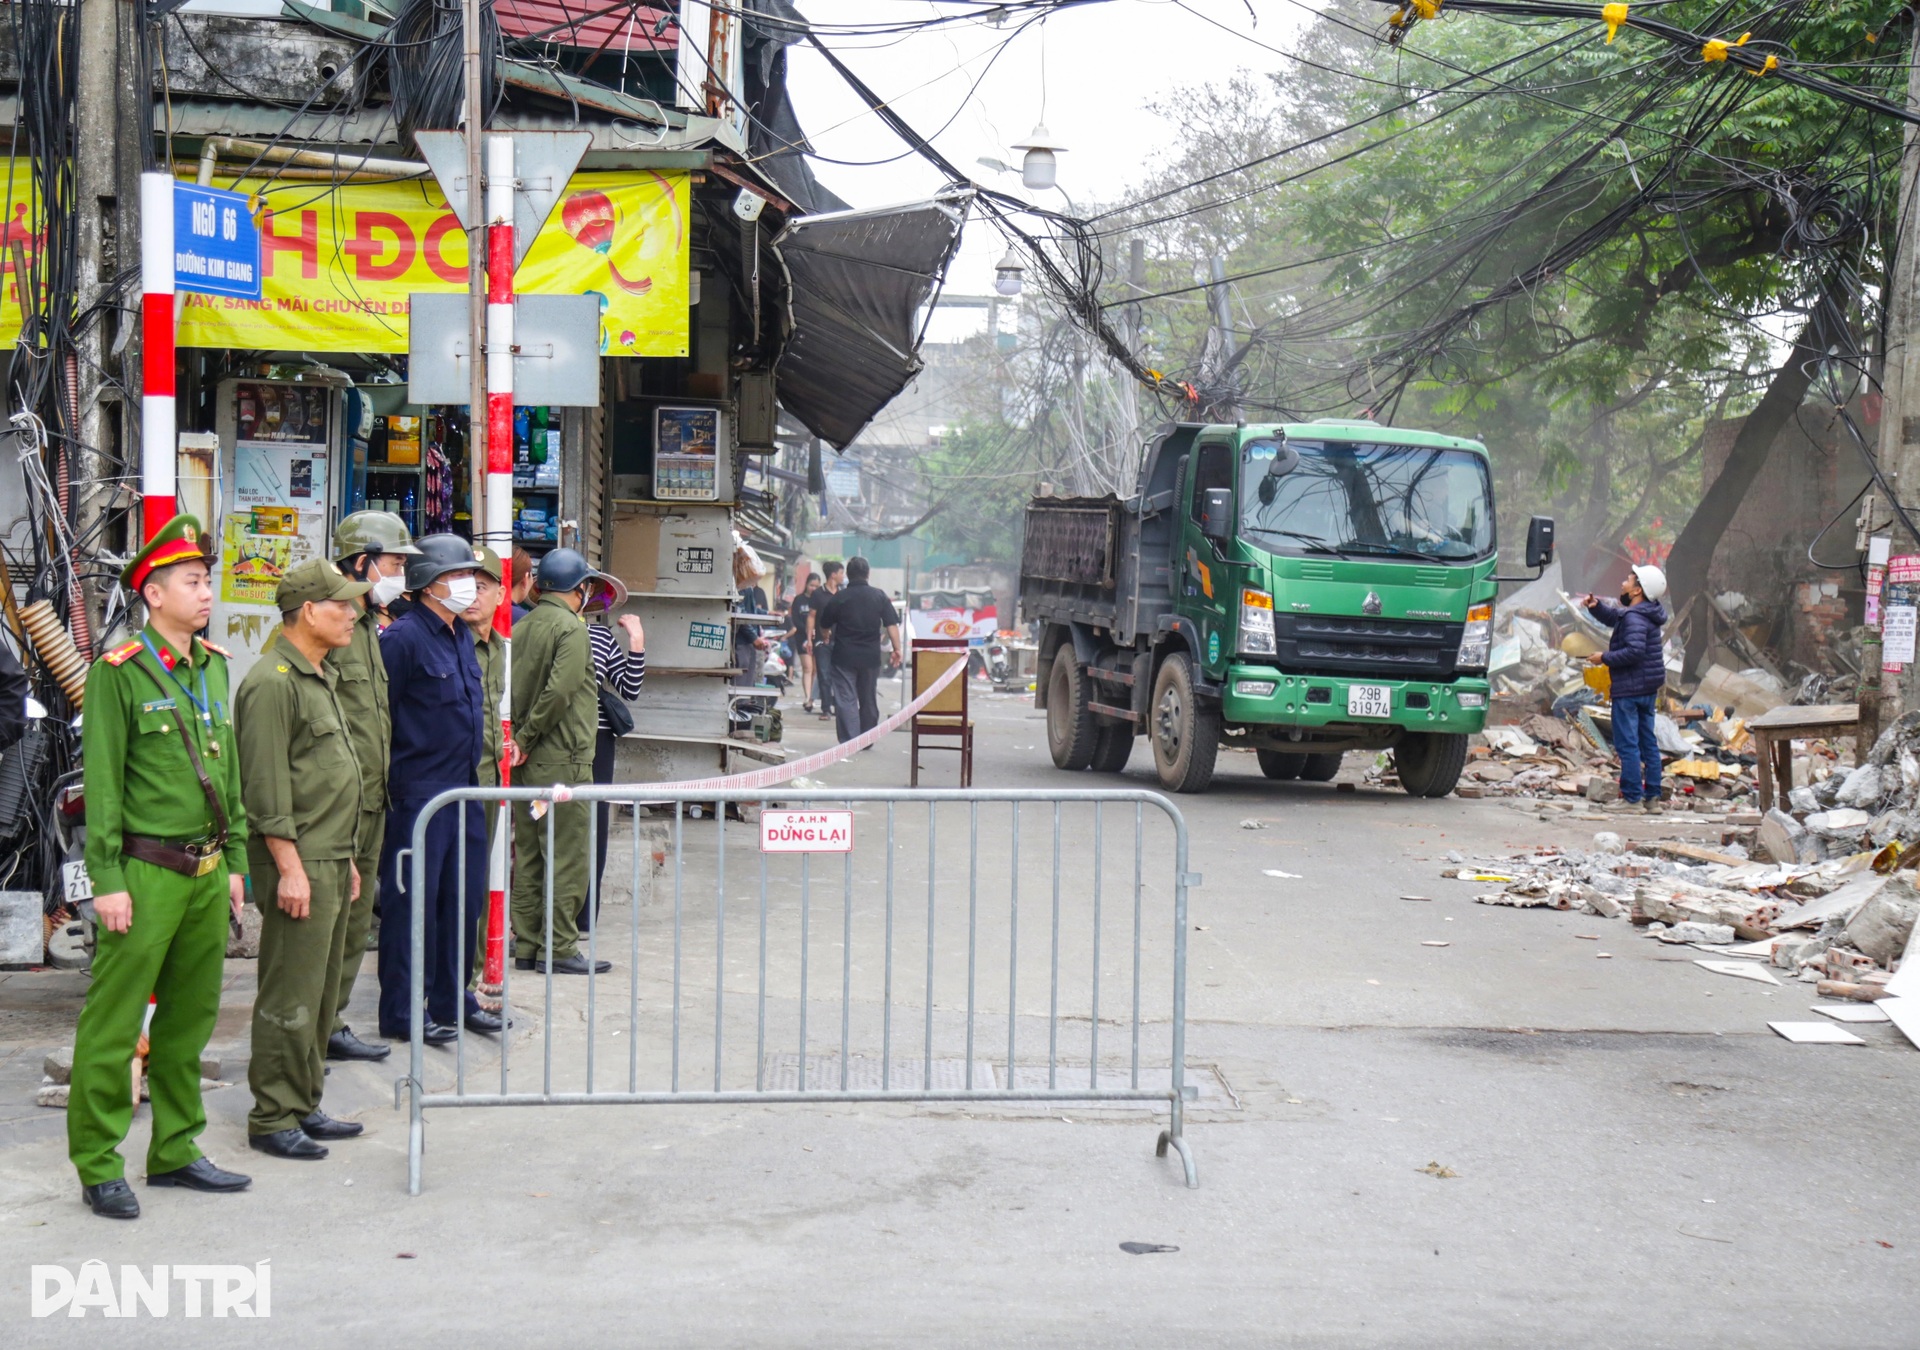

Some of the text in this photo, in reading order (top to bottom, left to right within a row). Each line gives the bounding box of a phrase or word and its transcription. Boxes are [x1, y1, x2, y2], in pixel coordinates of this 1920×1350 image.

[192, 198, 237, 241] NGÕ 66
[176, 249, 253, 282] ĐƯỜNG KIM GIANG
[277, 295, 309, 312] MÃI
[313, 297, 387, 317] CHUYỆN
[1359, 687, 1381, 701] 29B
[1350, 700, 1388, 715] 319.74
[787, 815, 828, 824] C.A.H.N
[768, 824, 846, 844] DỪNG LẠI
